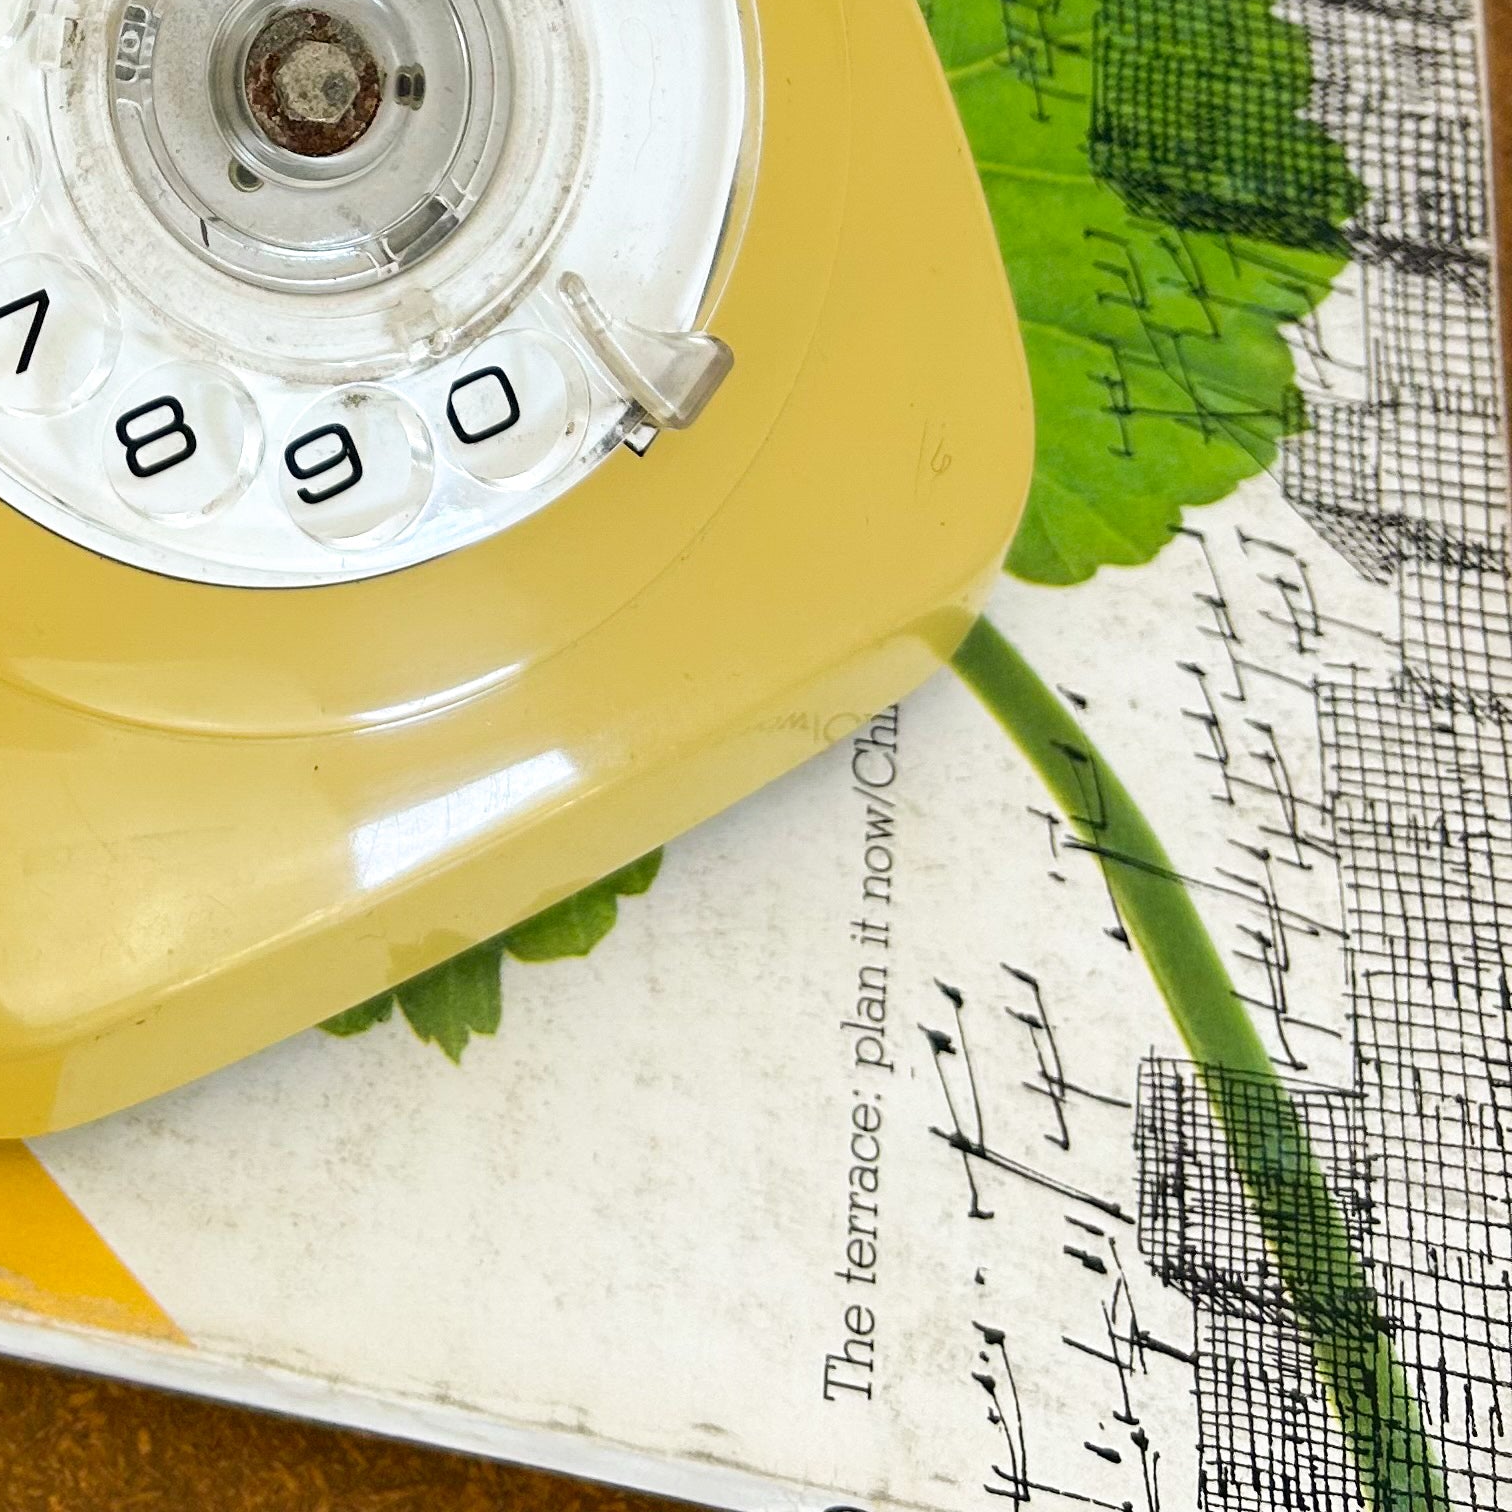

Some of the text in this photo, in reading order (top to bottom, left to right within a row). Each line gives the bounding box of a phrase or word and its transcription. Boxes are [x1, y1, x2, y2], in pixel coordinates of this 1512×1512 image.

[114, 395, 198, 478] 8
[445, 365, 520, 445] 0
[284, 422, 364, 506] 9
[850, 916, 890, 951] it
[840, 959, 896, 1074] plan
[835, 1088, 883, 1284] terrace:
[824, 1303, 877, 1404] The
